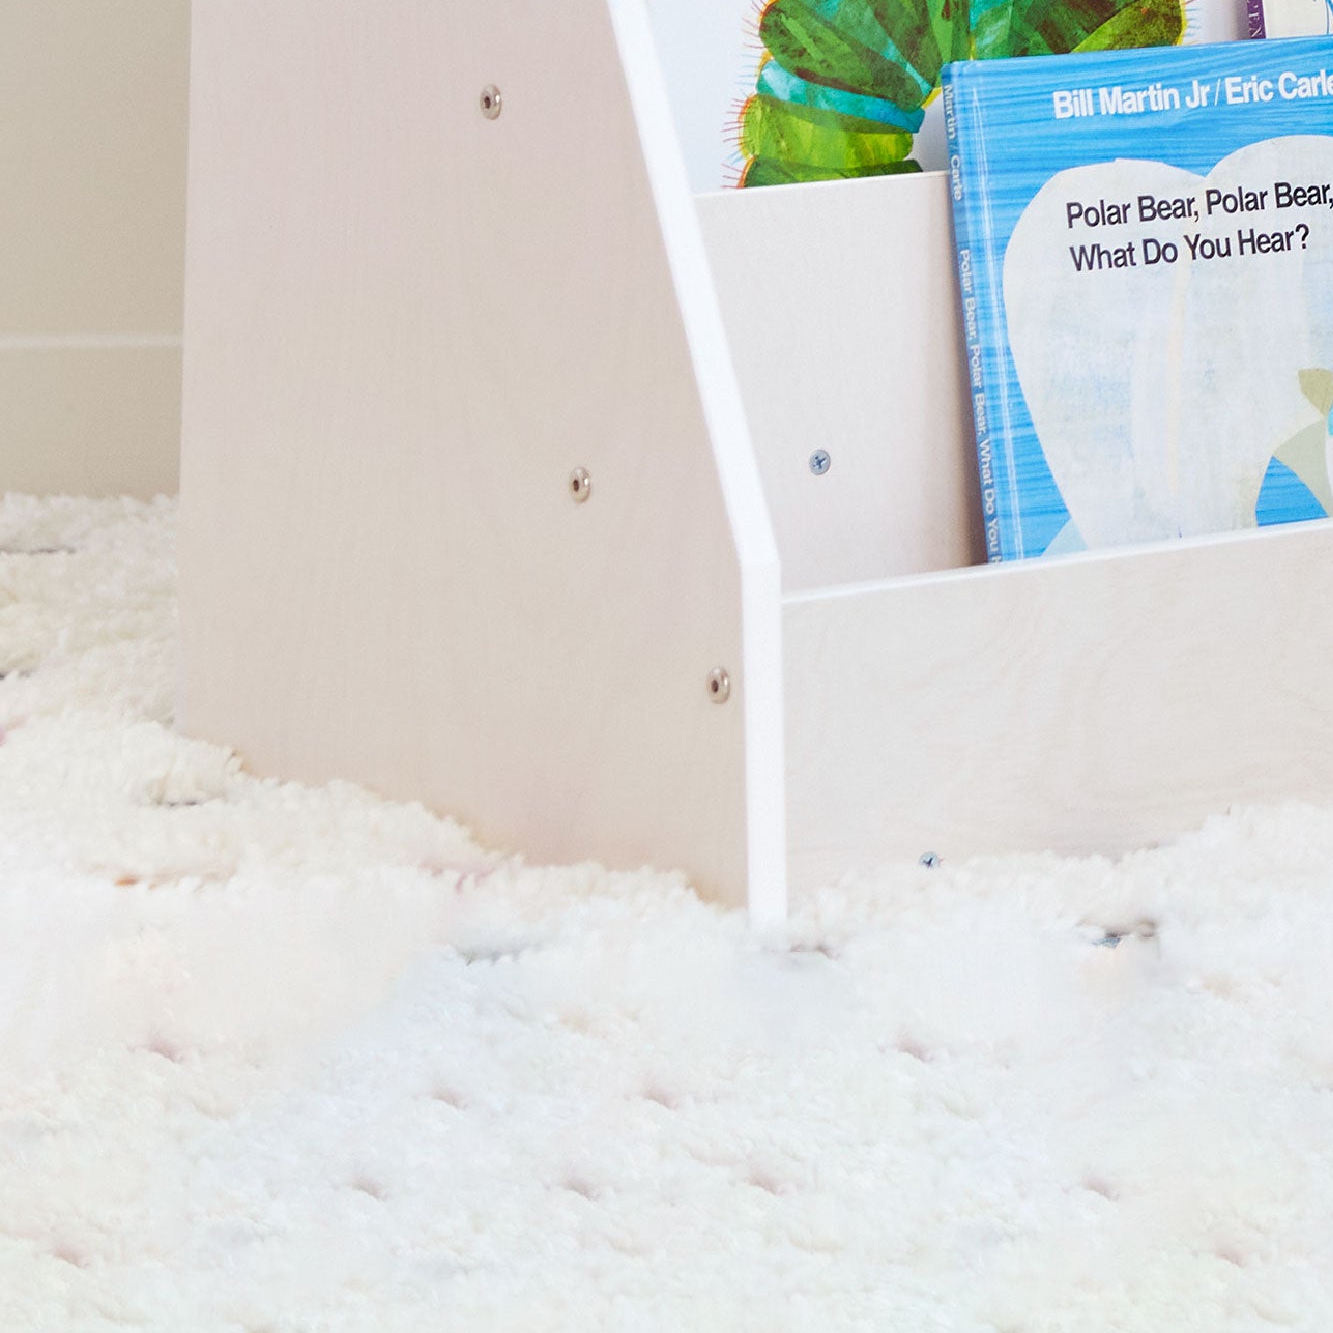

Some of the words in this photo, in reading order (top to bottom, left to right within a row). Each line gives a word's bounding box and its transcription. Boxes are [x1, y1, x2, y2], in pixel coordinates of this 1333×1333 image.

[1051, 87, 1095, 120] Bill
[1097, 82, 1182, 115] Martin
[1184, 79, 1211, 110] Jr
[1224, 74, 1275, 105] Eric
[944, 85, 957, 140] Martin
[951, 154, 962, 201] Carle
[1065, 197, 1131, 230] Polar
[1136, 191, 1200, 224] Bear,
[1204, 186, 1268, 217] Polar
[1068, 240, 1137, 272] What
[1142, 236, 1180, 266] Do
[1182, 230, 1233, 262] You
[1237, 222, 1311, 257] Hear?
[960, 250, 974, 295] Polar
[971, 344, 982, 388] Polar
[977, 439, 991, 485] What
[983, 488, 995, 515] Do
[988, 516, 999, 552] You
